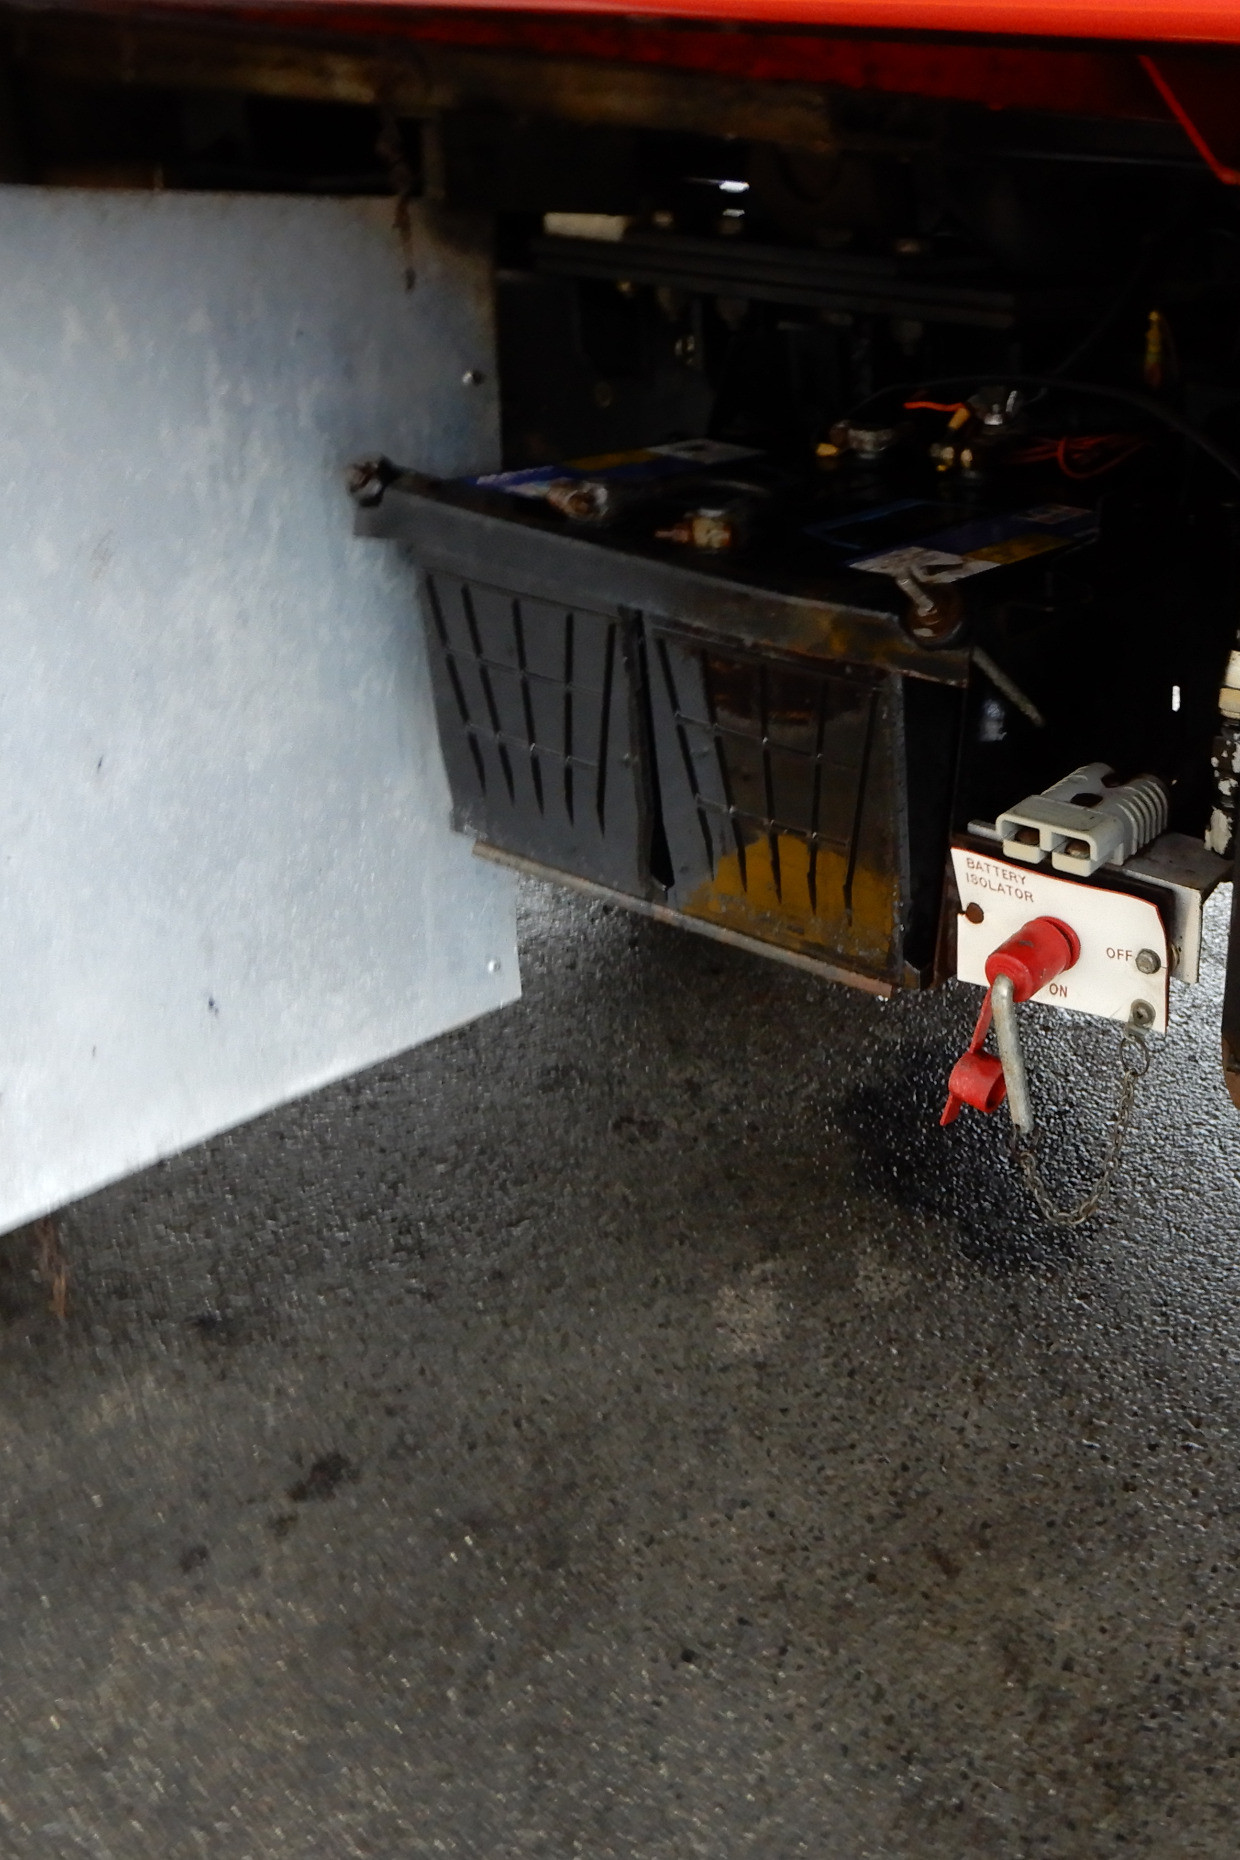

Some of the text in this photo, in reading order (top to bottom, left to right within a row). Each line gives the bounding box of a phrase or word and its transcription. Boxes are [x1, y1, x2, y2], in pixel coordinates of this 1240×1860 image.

[966, 857, 1027, 886] BATTERY
[965, 872, 1035, 904] ISOLATOR
[1106, 946, 1133, 961] OFF
[1049, 982, 1068, 998] ON
